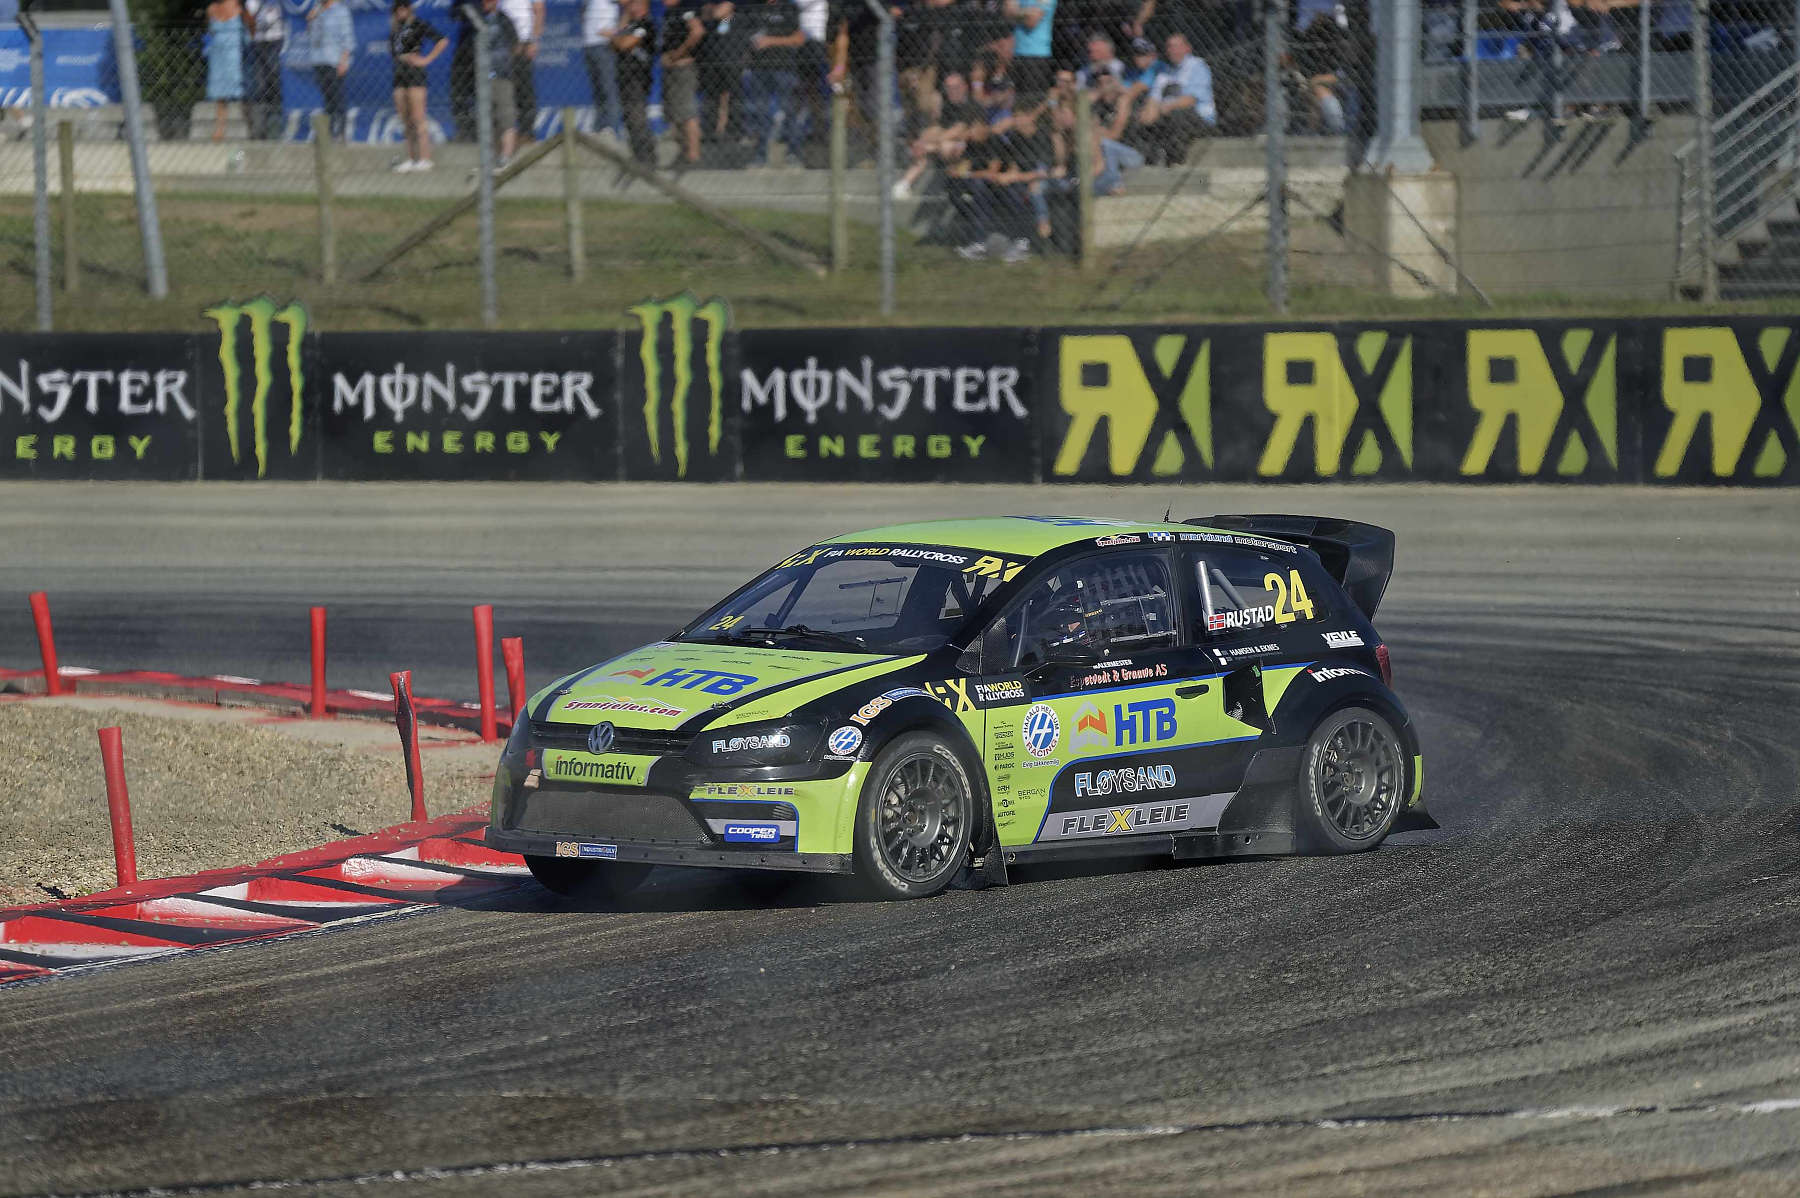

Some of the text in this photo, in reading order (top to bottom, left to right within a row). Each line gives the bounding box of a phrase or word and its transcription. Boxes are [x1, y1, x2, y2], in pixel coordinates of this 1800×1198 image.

[333, 362, 602, 422] MONSTER
[740, 355, 1029, 423] MONSTER
[1053, 333, 1213, 476] RX
[1256, 330, 1414, 477] RX
[1459, 328, 1618, 477] RX
[15, 433, 152, 460] ERGY
[373, 430, 562, 454] ENERGY
[784, 433, 986, 459] ENERGY
[824, 547, 969, 565] FIA WORLD RALLYCROSS
[1263, 568, 1315, 625] 24
[708, 614, 746, 632] 24
[1225, 605, 1275, 629] RUSTAD
[1229, 647, 1256, 657] HANSEN
[642, 667, 760, 696] HTB
[1155, 663, 1168, 677] AS
[978, 688, 1025, 702] RALLYCROSS
[563, 699, 685, 718] Synnfjellet.com
[849, 696, 893, 726] IGS
[1023, 705, 1060, 734] HARALD HELLUM
[1114, 698, 1178, 747] HTB
[712, 734, 791, 754] FLØYSAND
[1026, 738, 1058, 757] RACING
[554, 755, 636, 780] informativ
[706, 783, 795, 798] FLEXLEIE
[1074, 765, 1177, 798] FLØYSAND
[727, 826, 778, 835] COOPER
[1060, 803, 1191, 836] FLEXLEIE
[750, 832, 776, 840] TIRES
[555, 841, 579, 858] IGS
